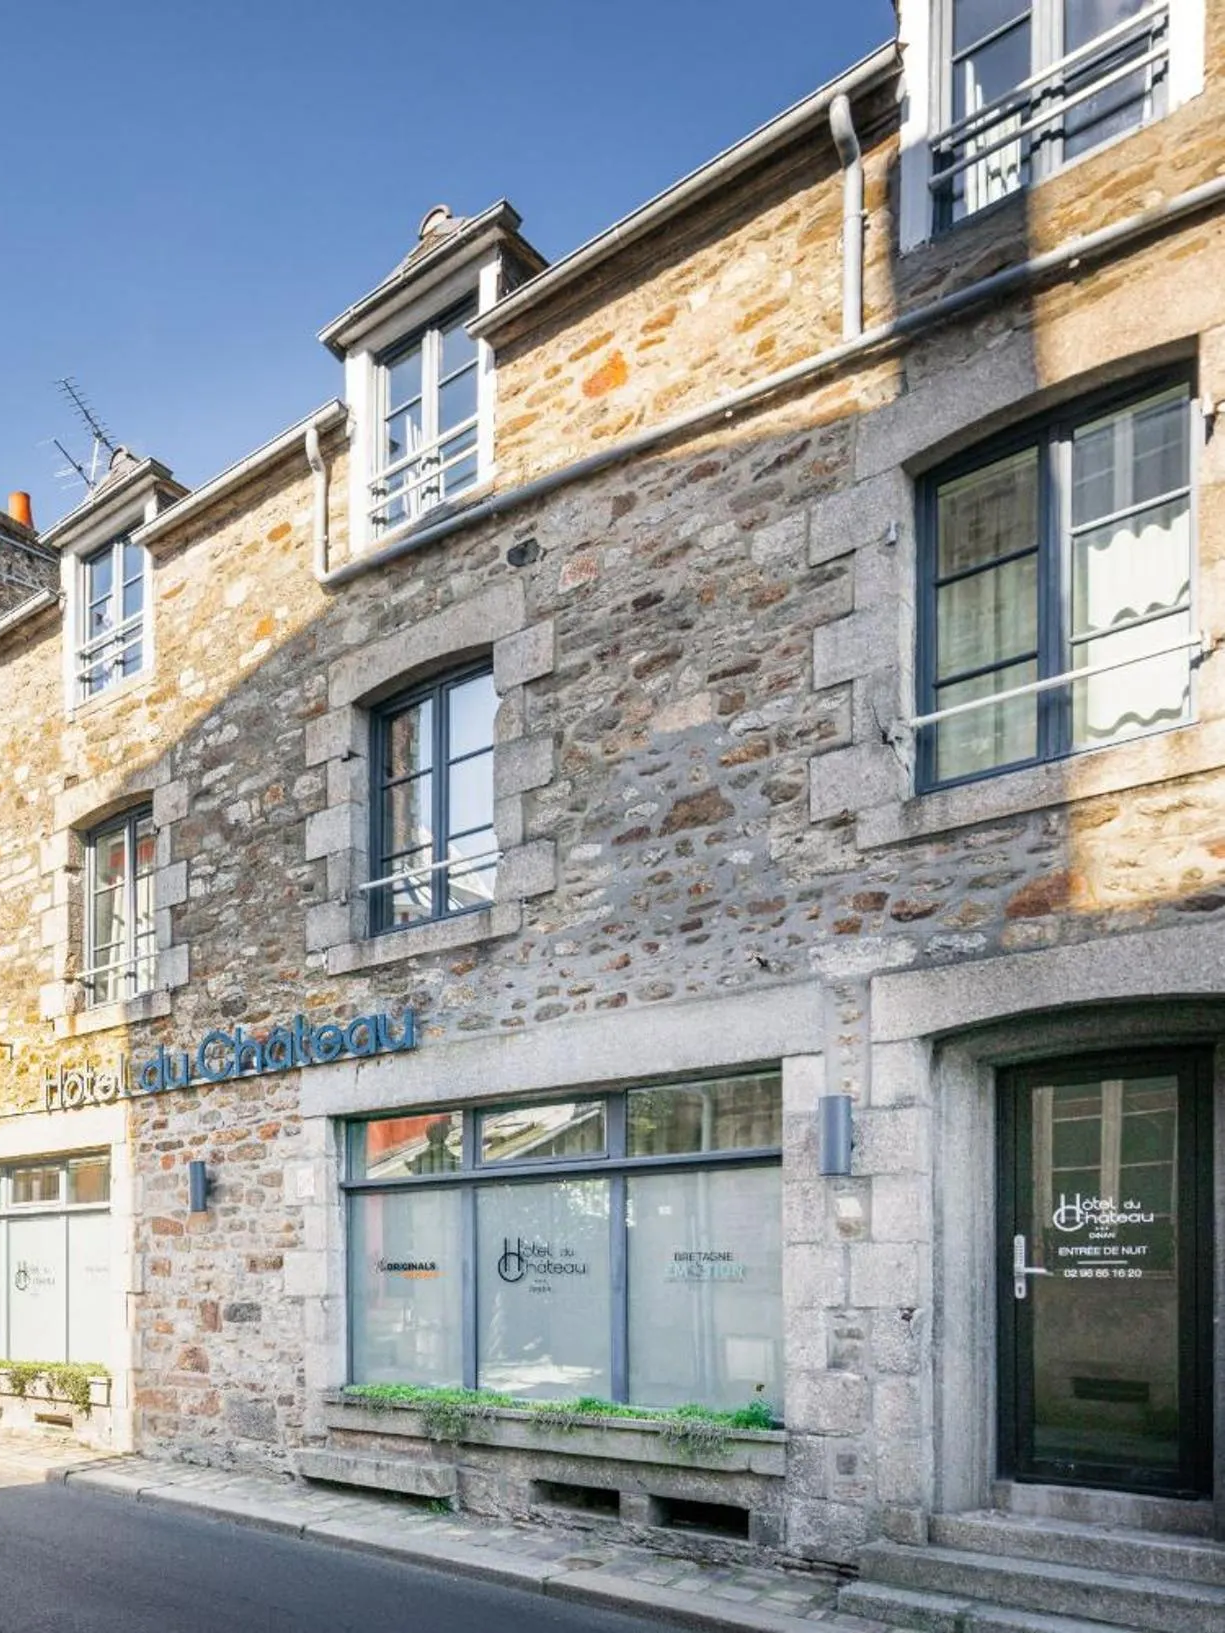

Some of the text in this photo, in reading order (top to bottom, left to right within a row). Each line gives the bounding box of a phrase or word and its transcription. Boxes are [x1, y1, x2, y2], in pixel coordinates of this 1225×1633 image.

[139, 1043, 190, 1092] du
[1122, 1198, 1142, 1210] du
[1103, 1245, 1119, 1255] DE
[1121, 1245, 1148, 1256] NUIT
[673, 1251, 735, 1262] BRETAGNE
[386, 1261, 437, 1271] ORIGINALS
[1063, 1267, 1078, 1279] 02
[1127, 1267, 1143, 1278] 20
